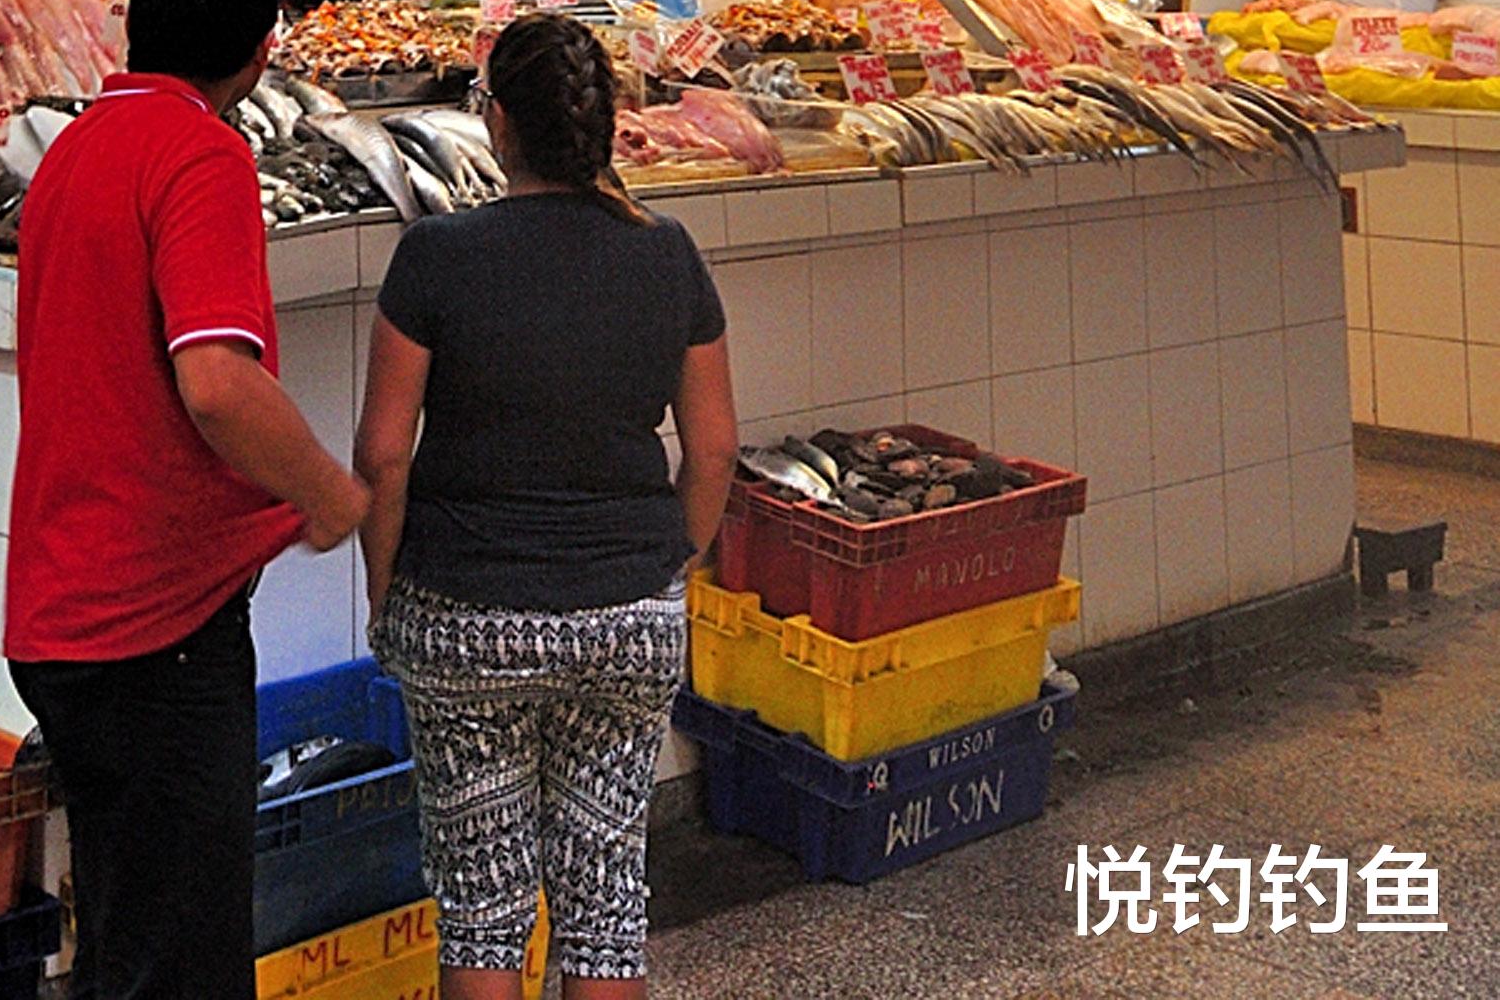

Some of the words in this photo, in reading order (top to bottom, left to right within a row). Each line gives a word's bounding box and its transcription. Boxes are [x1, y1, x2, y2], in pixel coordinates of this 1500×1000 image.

[913, 546, 1017, 594] MANOLO
[928, 726, 997, 770] WILSON
[299, 934, 351, 979] ML
[384, 907, 435, 958] ML
